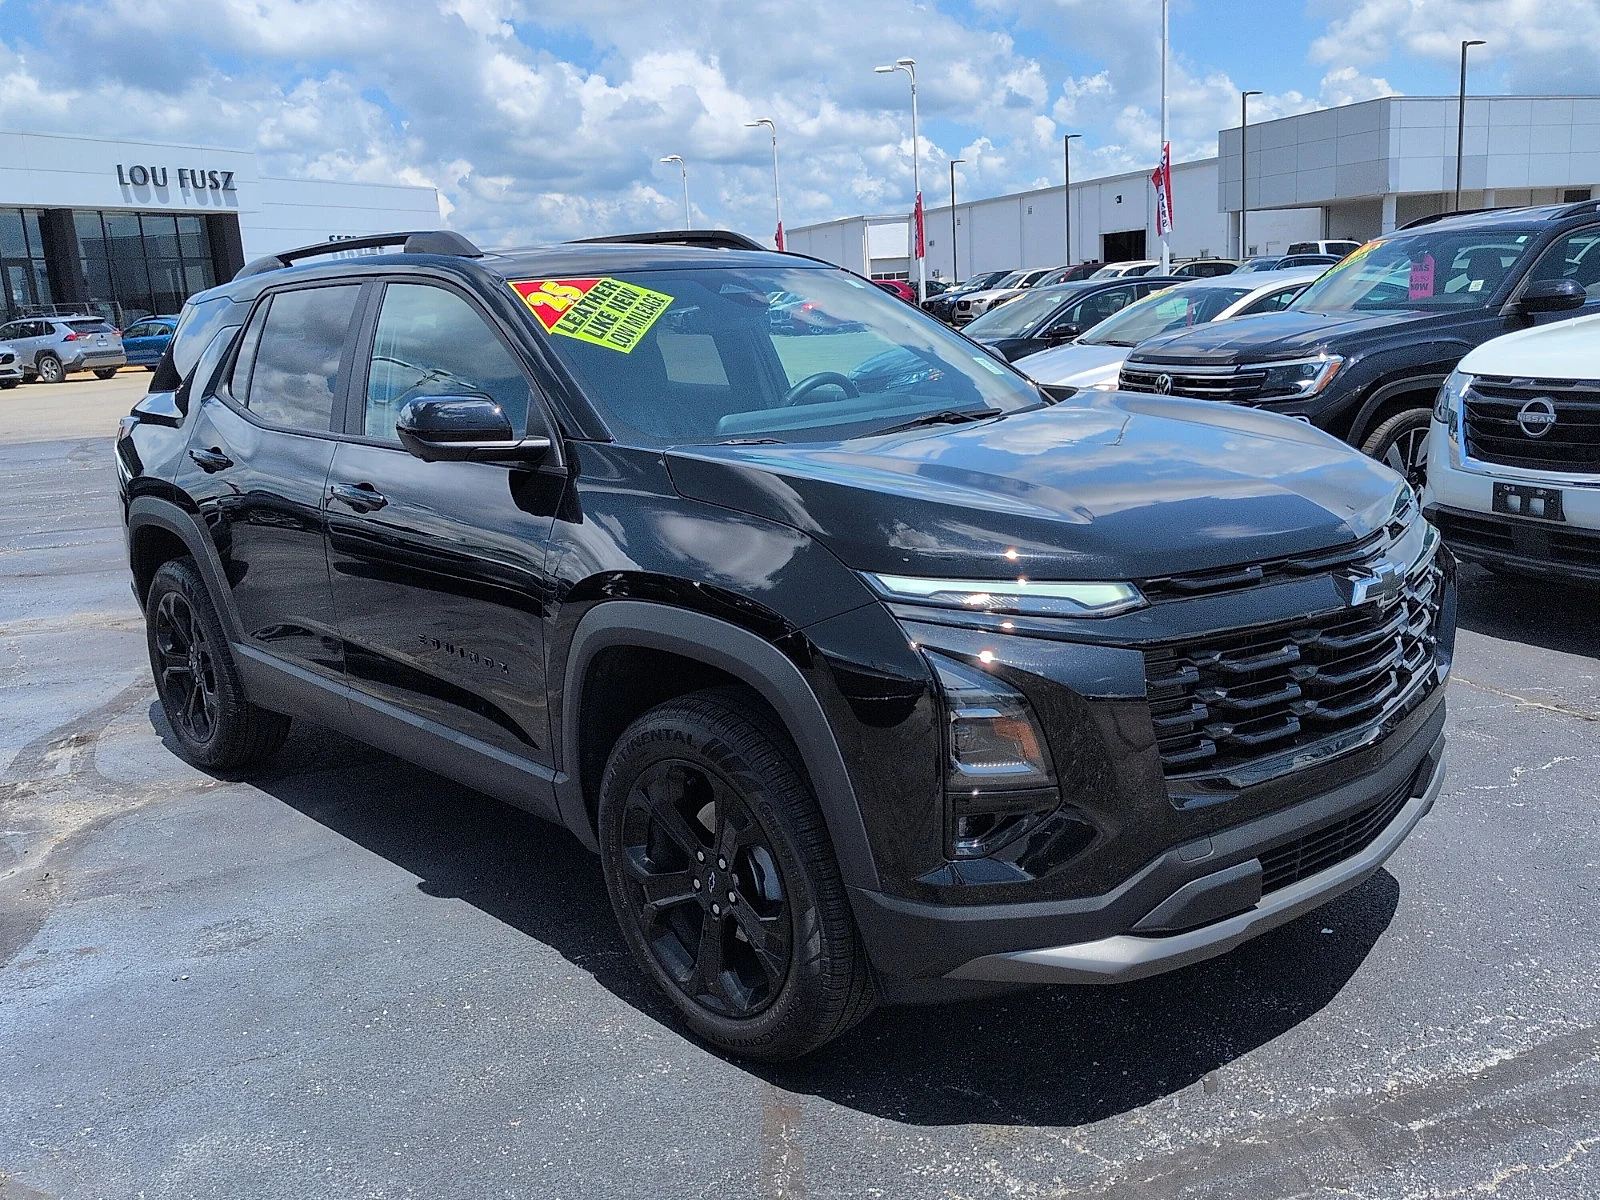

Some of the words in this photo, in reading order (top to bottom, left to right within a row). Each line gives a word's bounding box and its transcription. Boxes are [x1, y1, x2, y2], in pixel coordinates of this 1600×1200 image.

[117, 164, 168, 187] LOU
[178, 168, 237, 191] FUSZ
[526, 281, 584, 312] 25
[556, 280, 621, 335] LEATHER
[582, 310, 620, 340] LIKE
[605, 287, 641, 314] NEW
[607, 325, 638, 349] LOW
[623, 294, 666, 330] MILEAGE
[1517, 412, 1555, 423] NISSAN
